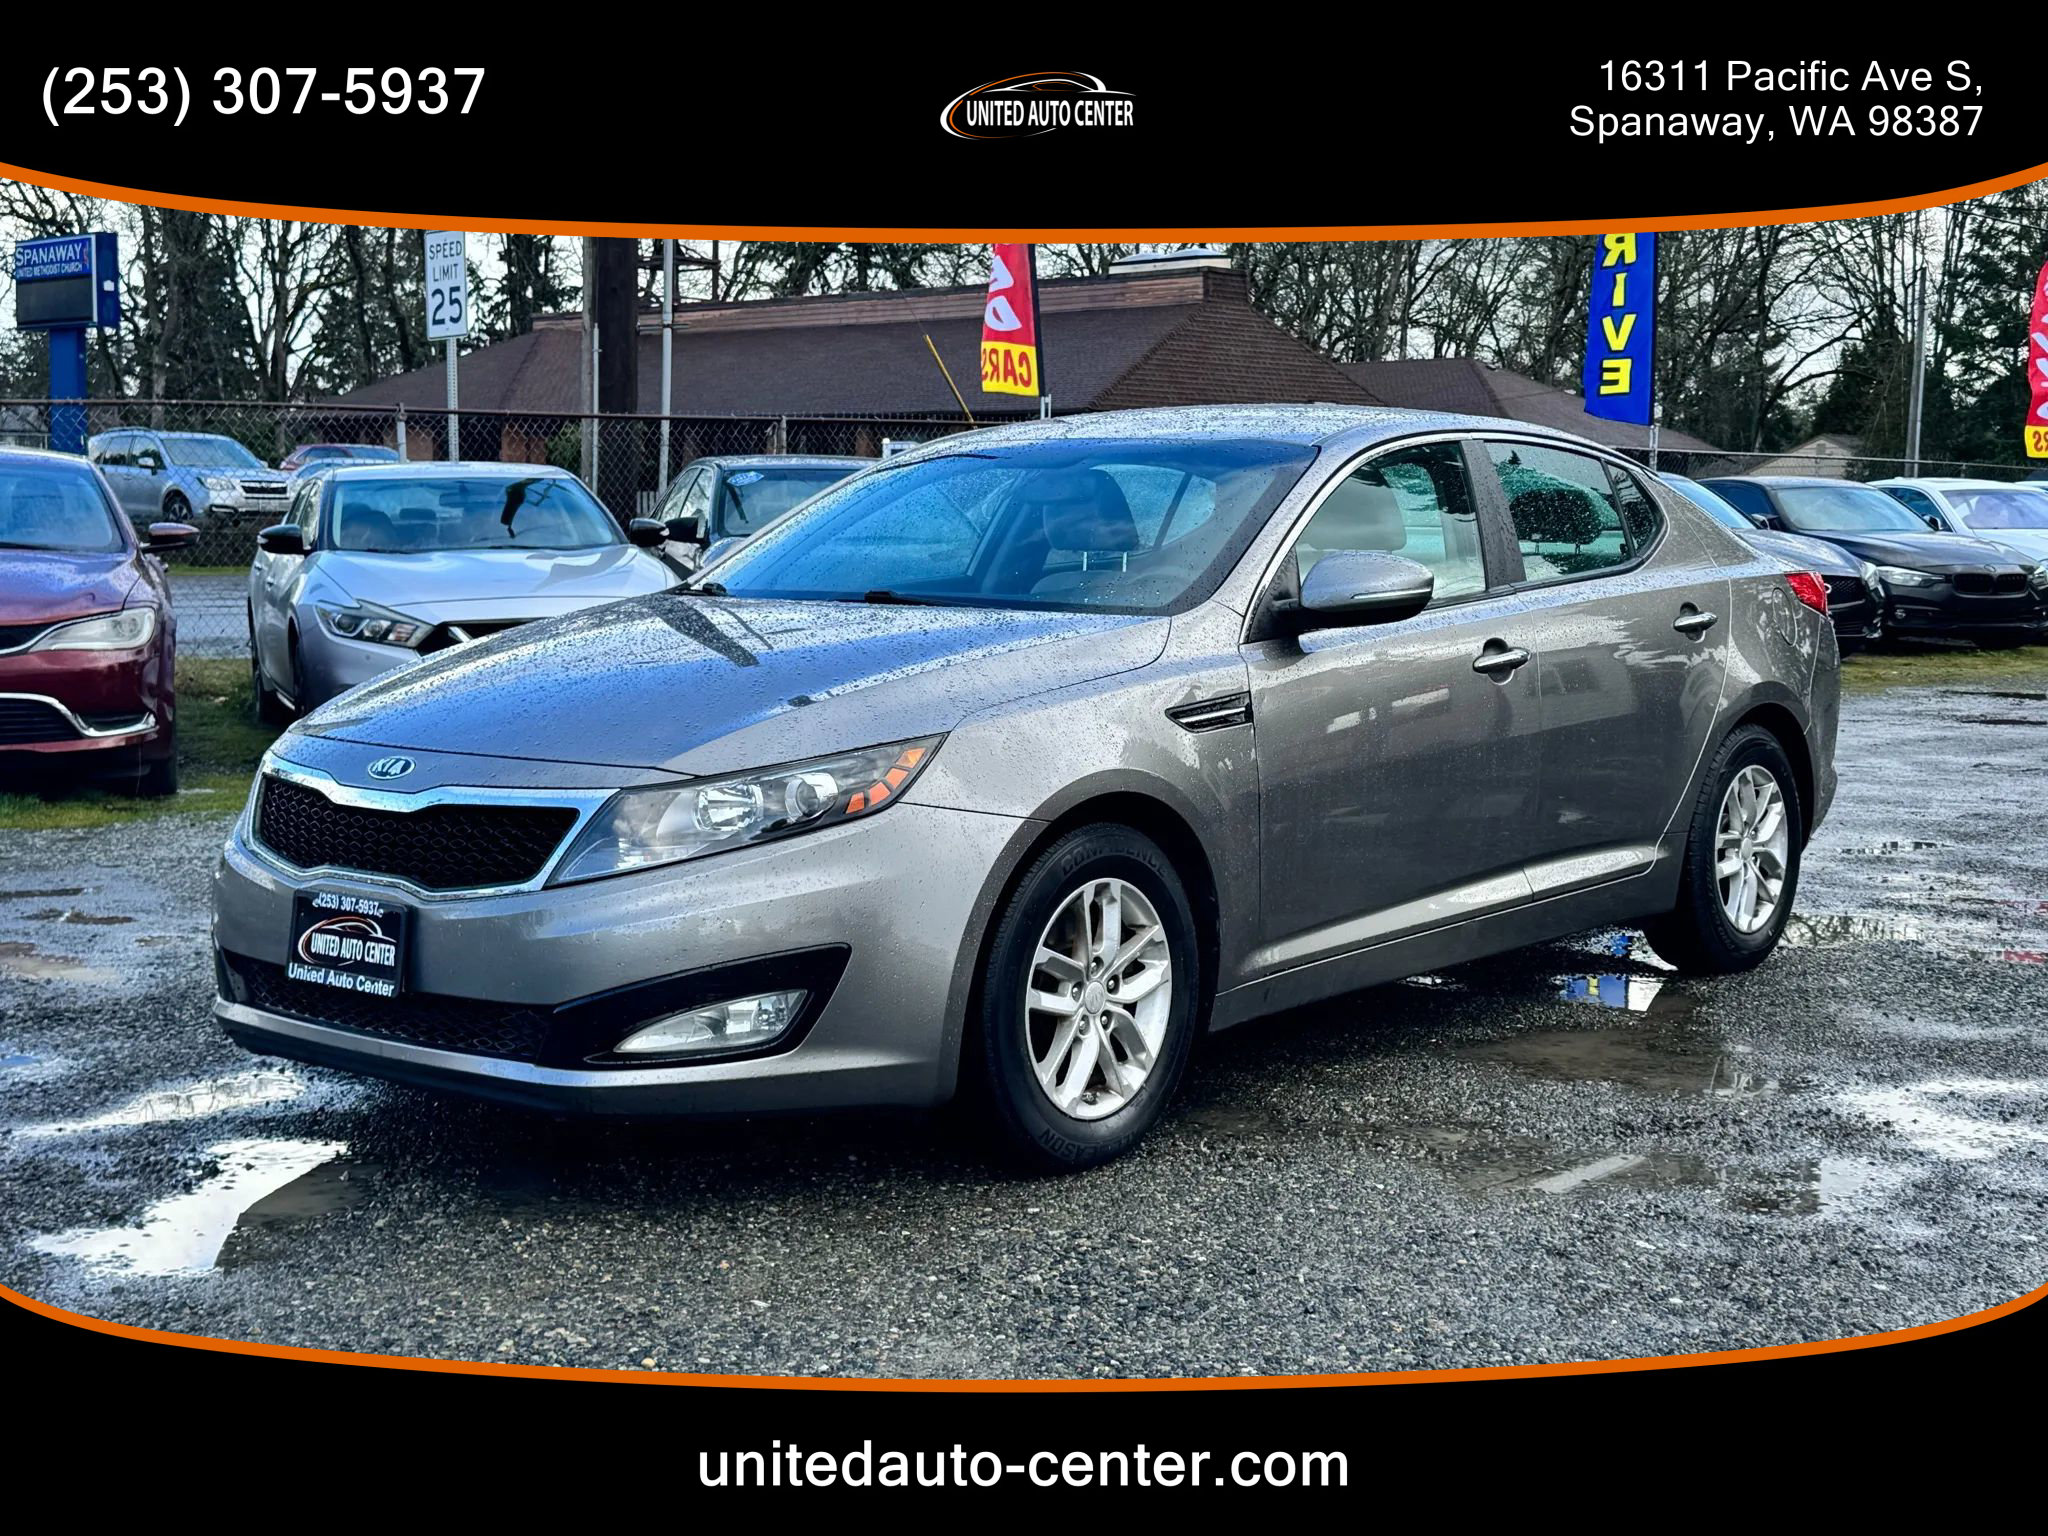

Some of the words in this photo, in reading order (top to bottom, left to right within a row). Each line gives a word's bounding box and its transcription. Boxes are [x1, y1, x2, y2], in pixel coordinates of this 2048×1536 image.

[15, 243, 82, 266] SPANAWAY
[429, 241, 463, 260] SPEED
[33, 263, 60, 276] METHODIST
[61, 261, 82, 274] CHURCH
[433, 263, 459, 282] LIMIT
[431, 286, 463, 326] 25
[371, 758, 407, 776] KIA
[319, 892, 340, 910] (253)
[341, 896, 379, 917] 307-5937
[310, 932, 340, 957] UNITED
[340, 937, 363, 961] AUTO
[364, 941, 396, 967] CENTER
[288, 962, 325, 984] United
[326, 970, 354, 989] Auto
[356, 975, 394, 997] Center
